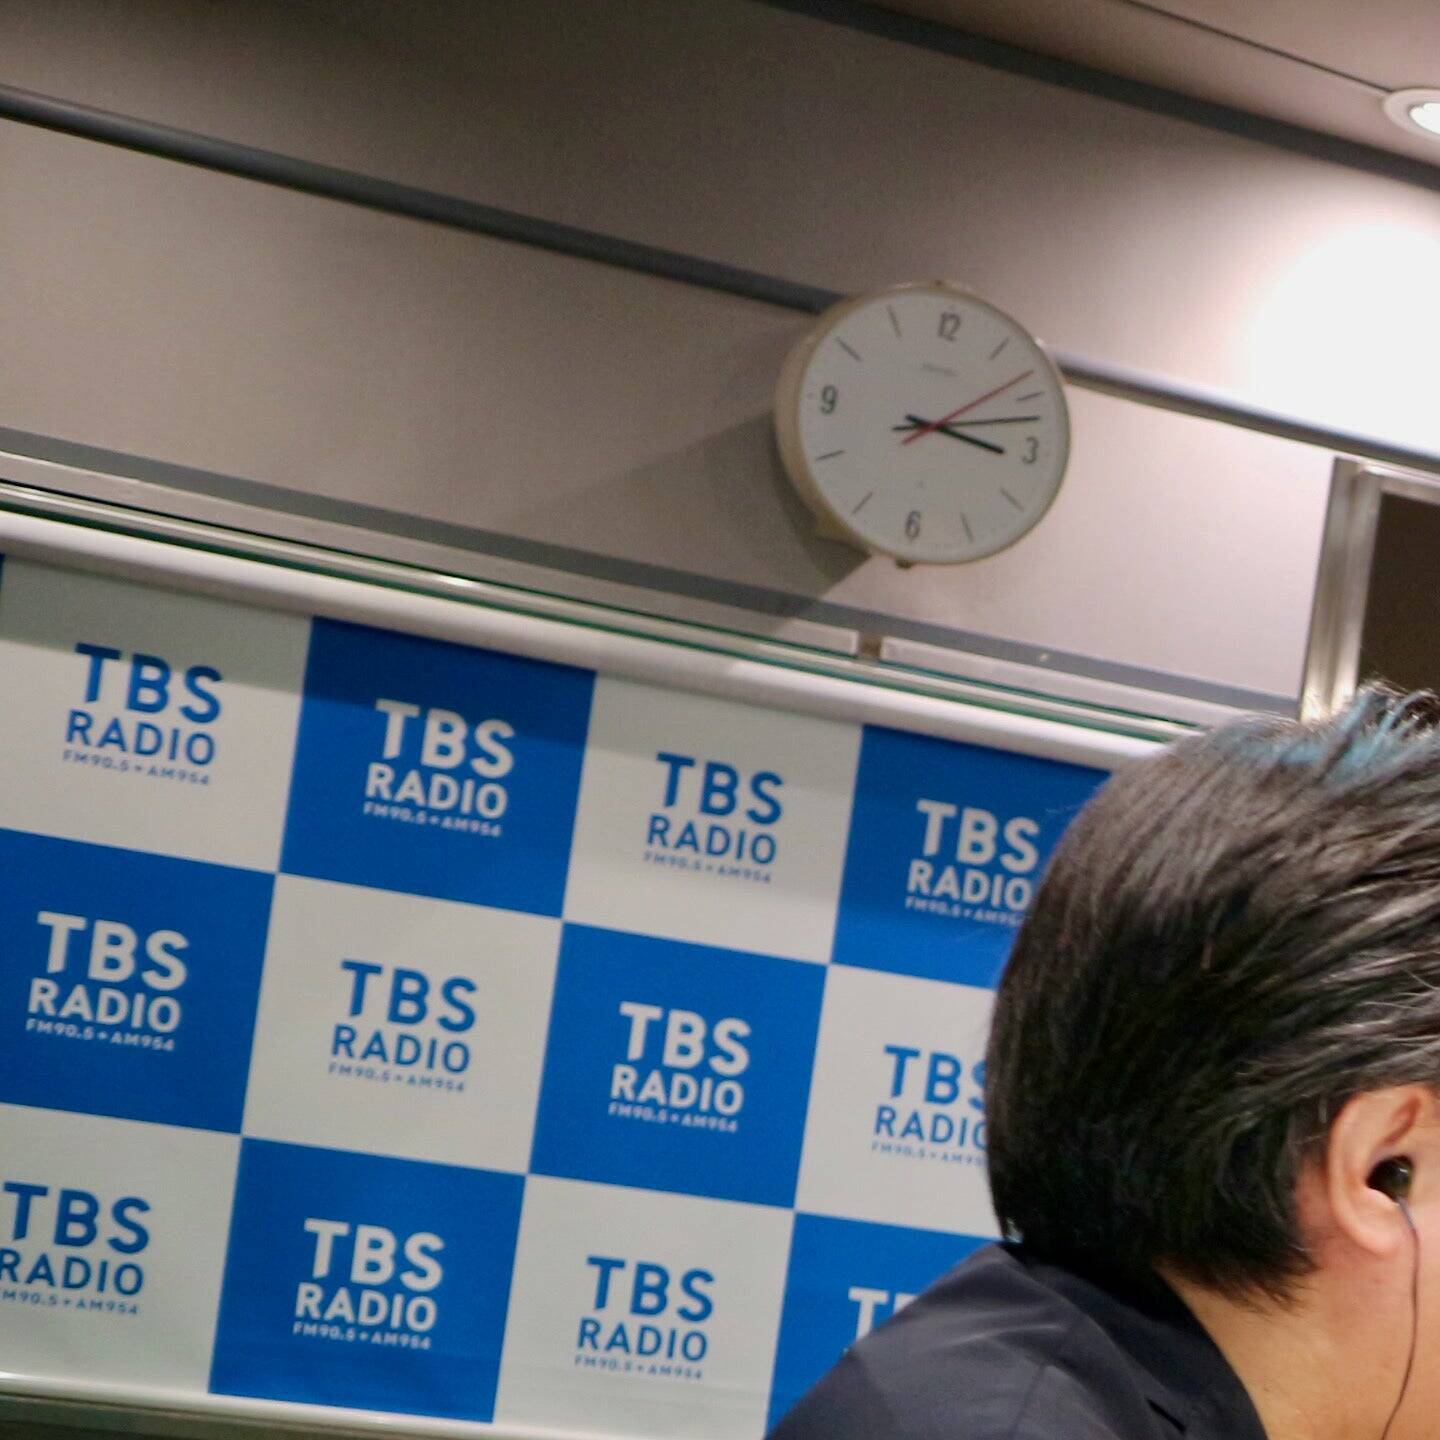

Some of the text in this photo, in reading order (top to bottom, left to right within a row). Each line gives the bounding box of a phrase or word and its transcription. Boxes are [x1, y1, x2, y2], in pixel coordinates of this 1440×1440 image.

[937, 312, 960, 342] 12
[821, 385, 839, 415] 9
[1022, 436, 1039, 465] 3
[904, 510, 922, 541] 6
[74, 642, 224, 724] TBS
[64, 710, 216, 767] RADIO
[375, 698, 515, 779] TBS
[365, 762, 508, 819] RADIO
[656, 751, 785, 825] TBS
[646, 814, 776, 865] RADIO
[916, 798, 1040, 873] TBS
[907, 859, 1032, 911] RADIO
[36, 910, 190, 991] TBS
[28, 977, 182, 1033] RADIO
[340, 959, 478, 1033] TBS
[332, 1025, 471, 1074] RADIO
[618, 1001, 752, 1077] TBS
[610, 1064, 744, 1117] RADIO
[3, 1182, 150, 1254] TBS
[0, 1248, 144, 1295] RADIO
[303, 1217, 445, 1292] TBS
[294, 1282, 438, 1333] RADIO
[586, 1255, 716, 1323] TBS
[577, 1318, 709, 1363] RADIO
